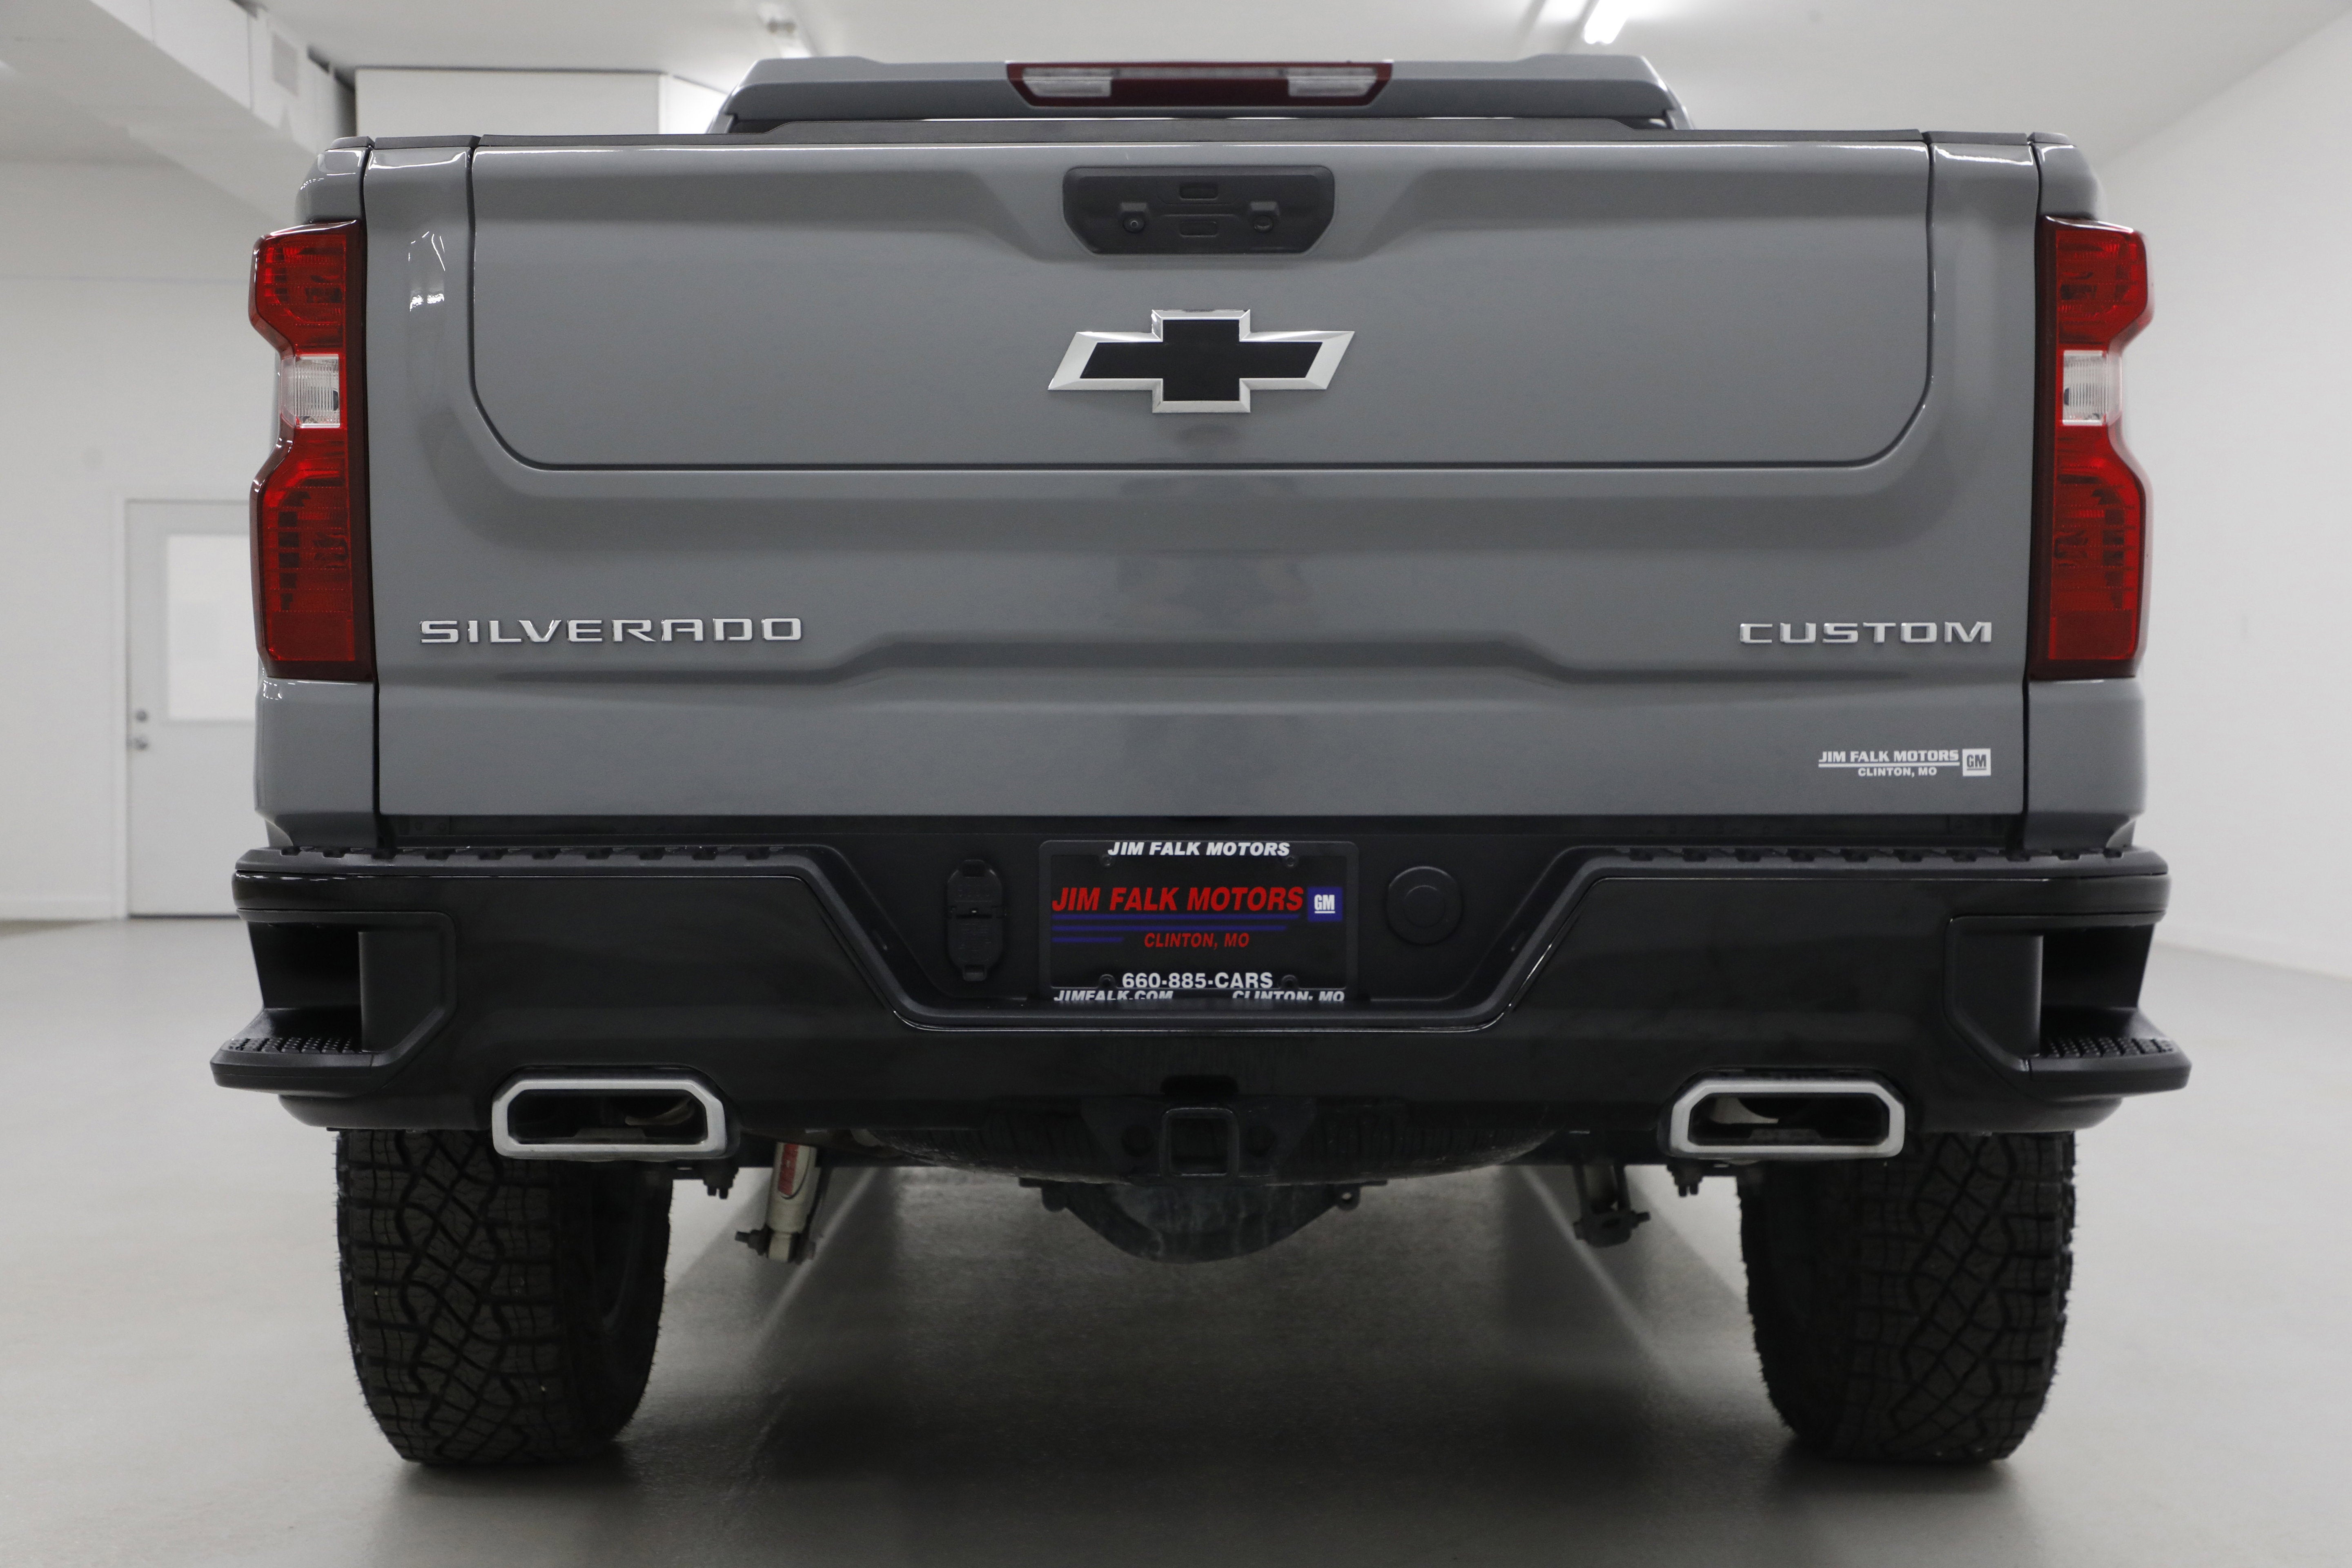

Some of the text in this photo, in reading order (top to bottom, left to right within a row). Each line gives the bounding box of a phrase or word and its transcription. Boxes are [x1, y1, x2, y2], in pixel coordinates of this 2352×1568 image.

[420, 618, 801, 642] SILVERADO
[1740, 621, 1991, 643] CUSTOM
[1819, 750, 1958, 762] JIM FALK MOTORS
[1967, 755, 1986, 767] GM
[1858, 767, 1937, 777] CLINTON, MO
[1108, 842, 1290, 856] JIM FALK MOTORS
[1052, 886, 1303, 911] JIM FALK MOTORS
[1314, 895, 1334, 911] GM
[1145, 933, 1249, 949] CLINTON, MO
[1123, 972, 1272, 988] 660-885-CARS
[1319, 991, 1344, 1002] MO
